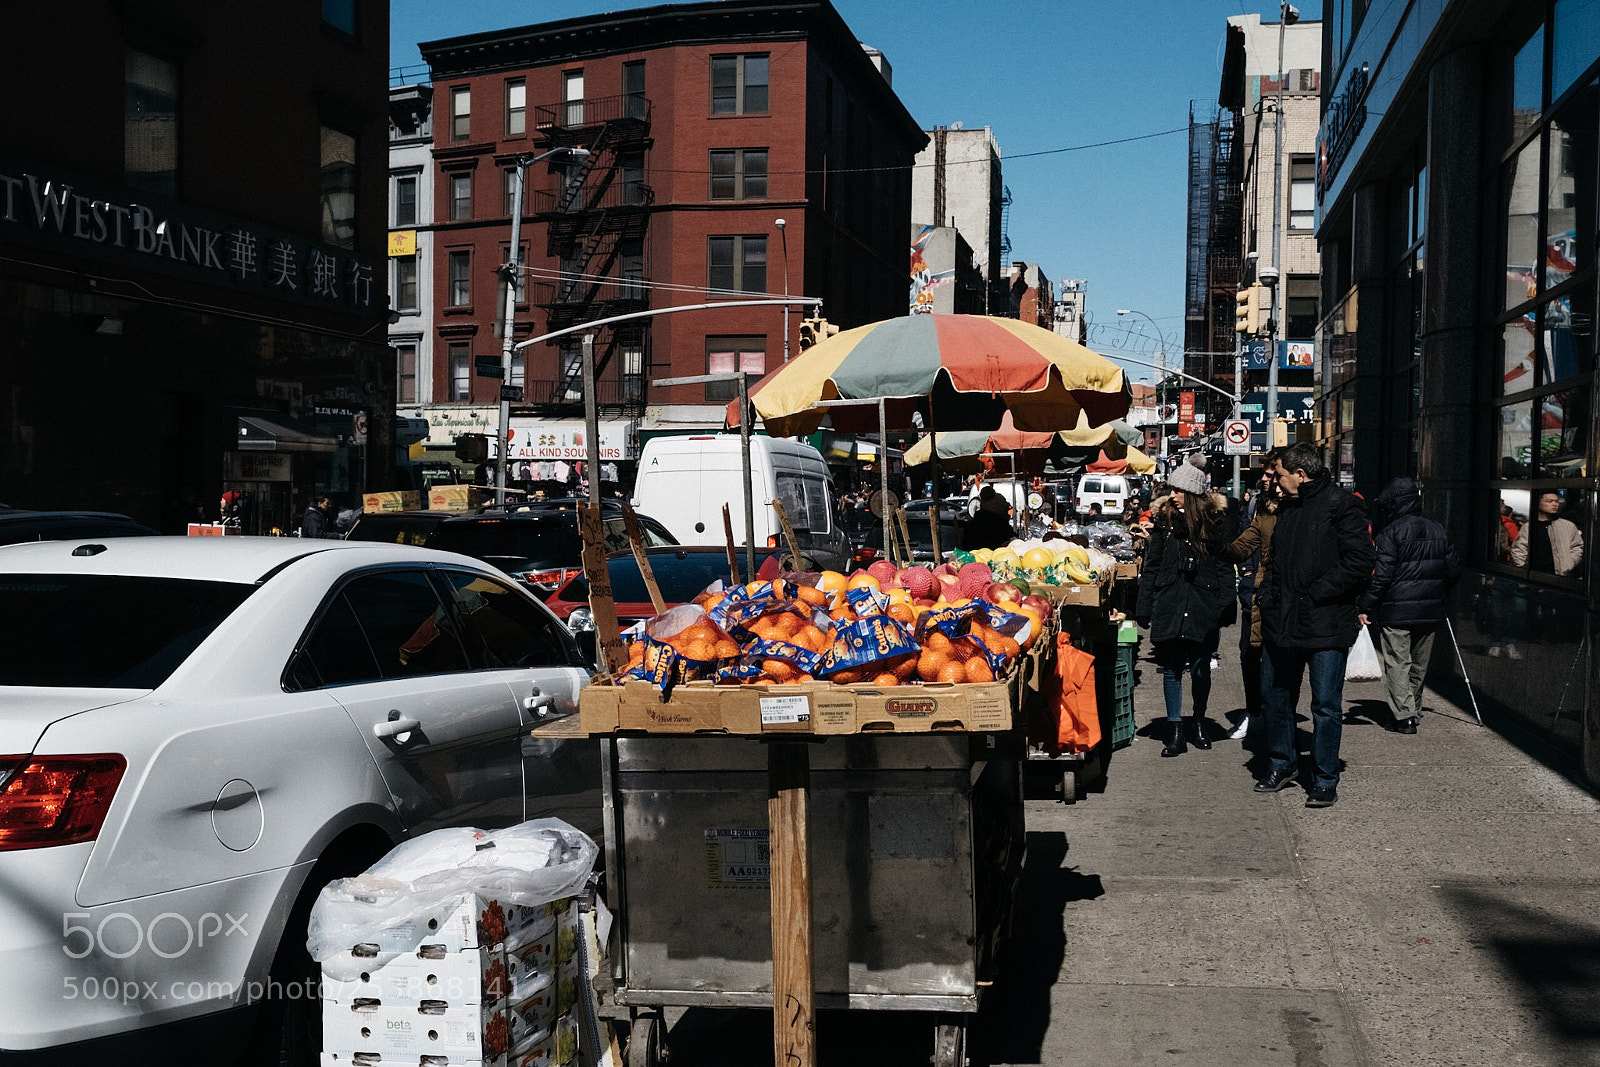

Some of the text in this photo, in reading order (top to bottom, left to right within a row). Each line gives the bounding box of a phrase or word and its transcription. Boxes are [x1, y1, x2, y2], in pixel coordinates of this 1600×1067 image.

[229, 229, 374, 307] 華美銀行
[519, 447, 621, 458] ALL KIND SOUVNIRS
[651, 456, 659, 466] A
[872, 618, 891, 656] Cuties
[654, 645, 673, 684] Cuties
[888, 700, 934, 713] GIANT
[728, 867, 770, 876] AA0217
[386, 1019, 411, 1030] beta
